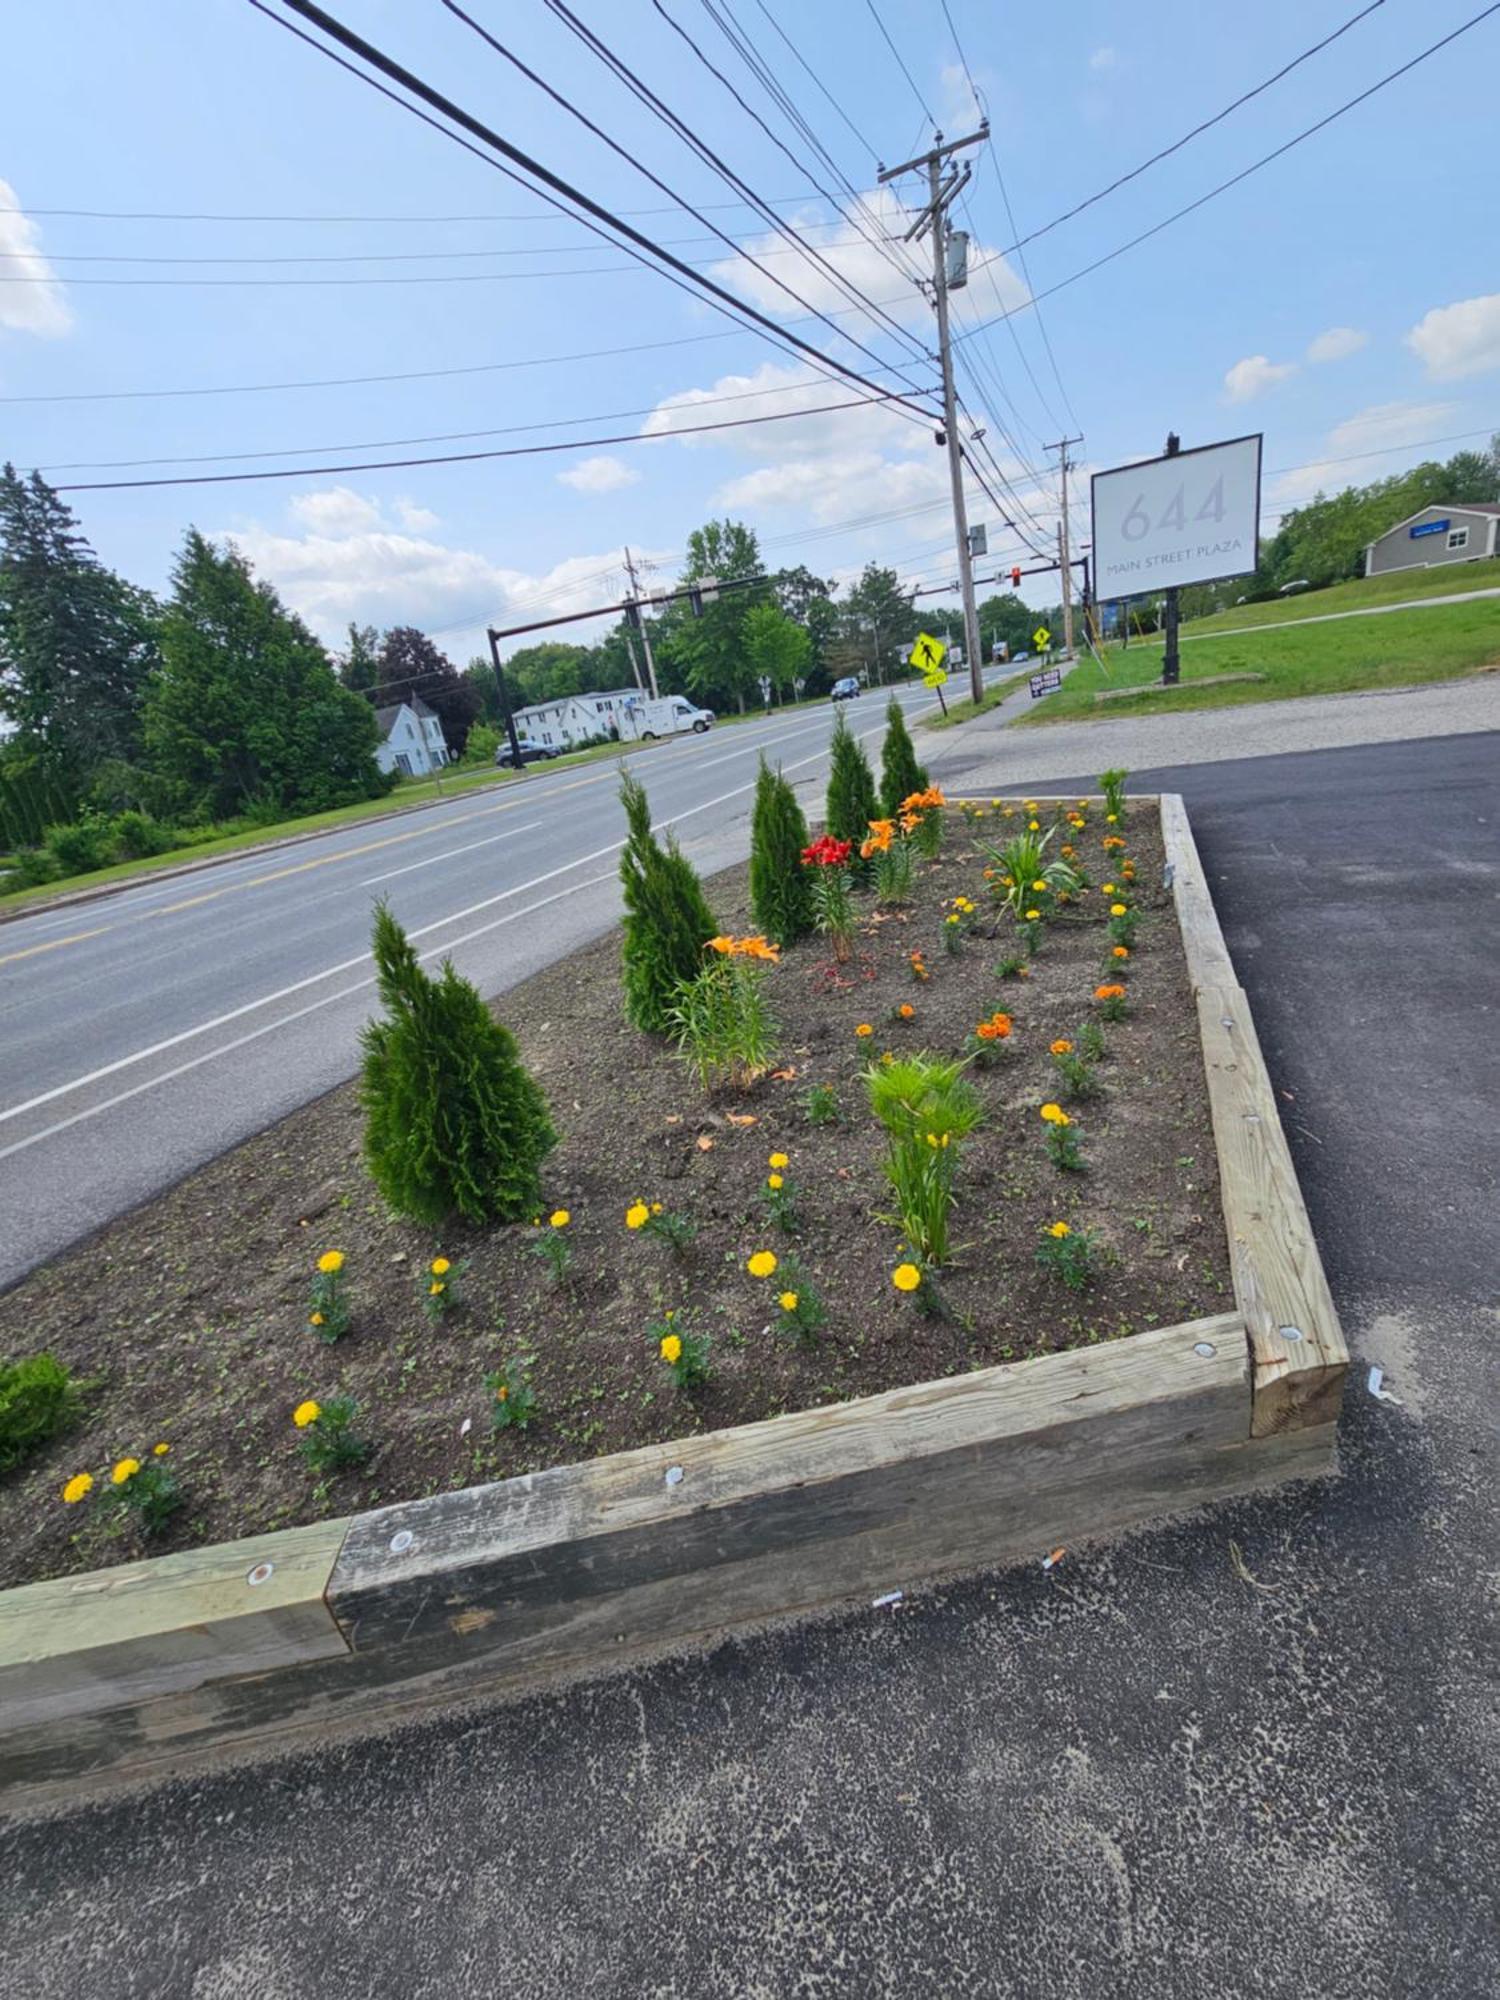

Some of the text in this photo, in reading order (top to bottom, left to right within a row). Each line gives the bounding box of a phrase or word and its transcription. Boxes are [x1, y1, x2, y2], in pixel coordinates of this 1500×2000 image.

[1121, 471, 1227, 541] 644
[1107, 539, 1242, 576] MAIN STREET PLAZA
